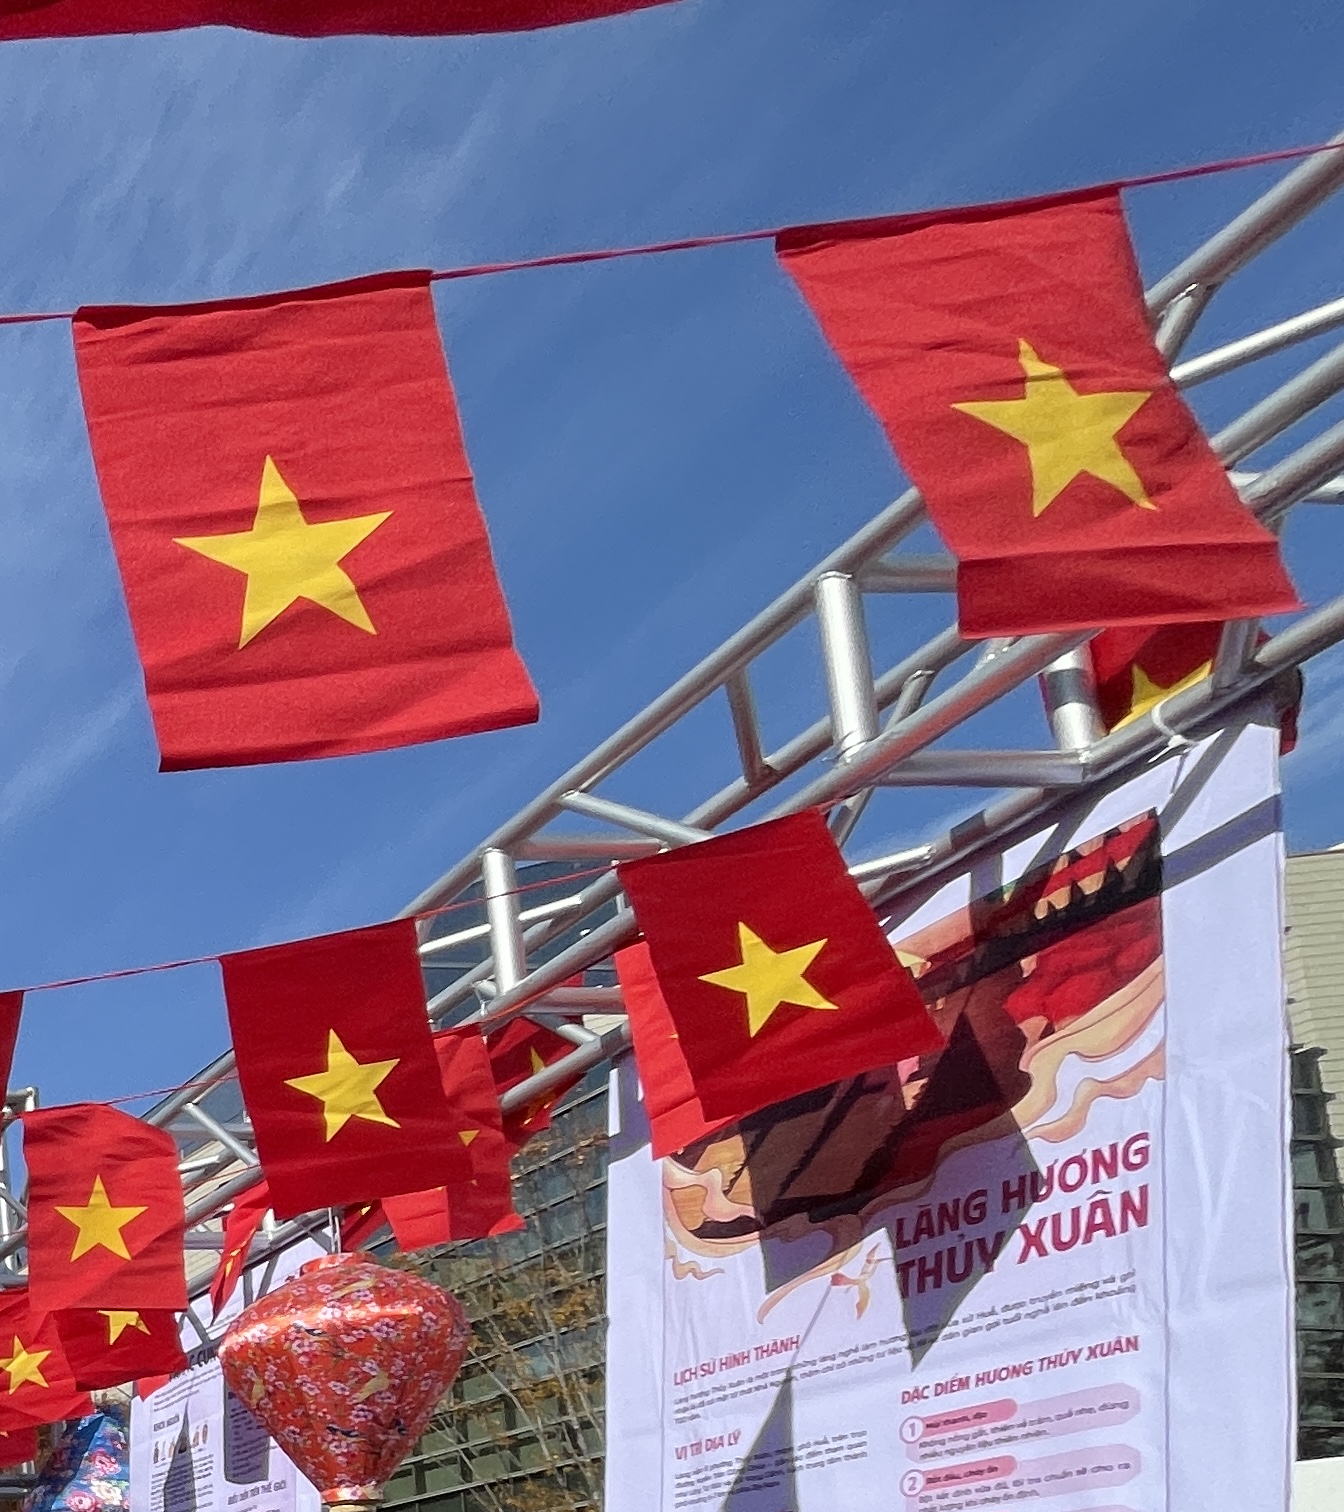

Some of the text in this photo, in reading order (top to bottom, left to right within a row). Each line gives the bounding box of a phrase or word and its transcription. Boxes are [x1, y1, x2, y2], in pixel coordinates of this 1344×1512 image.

[895, 1131, 1150, 1250] LÀNG HƯƠNG
[897, 1184, 1149, 1298] THỦY XUÂN
[1085, 1335, 1140, 1361] XUÂN
